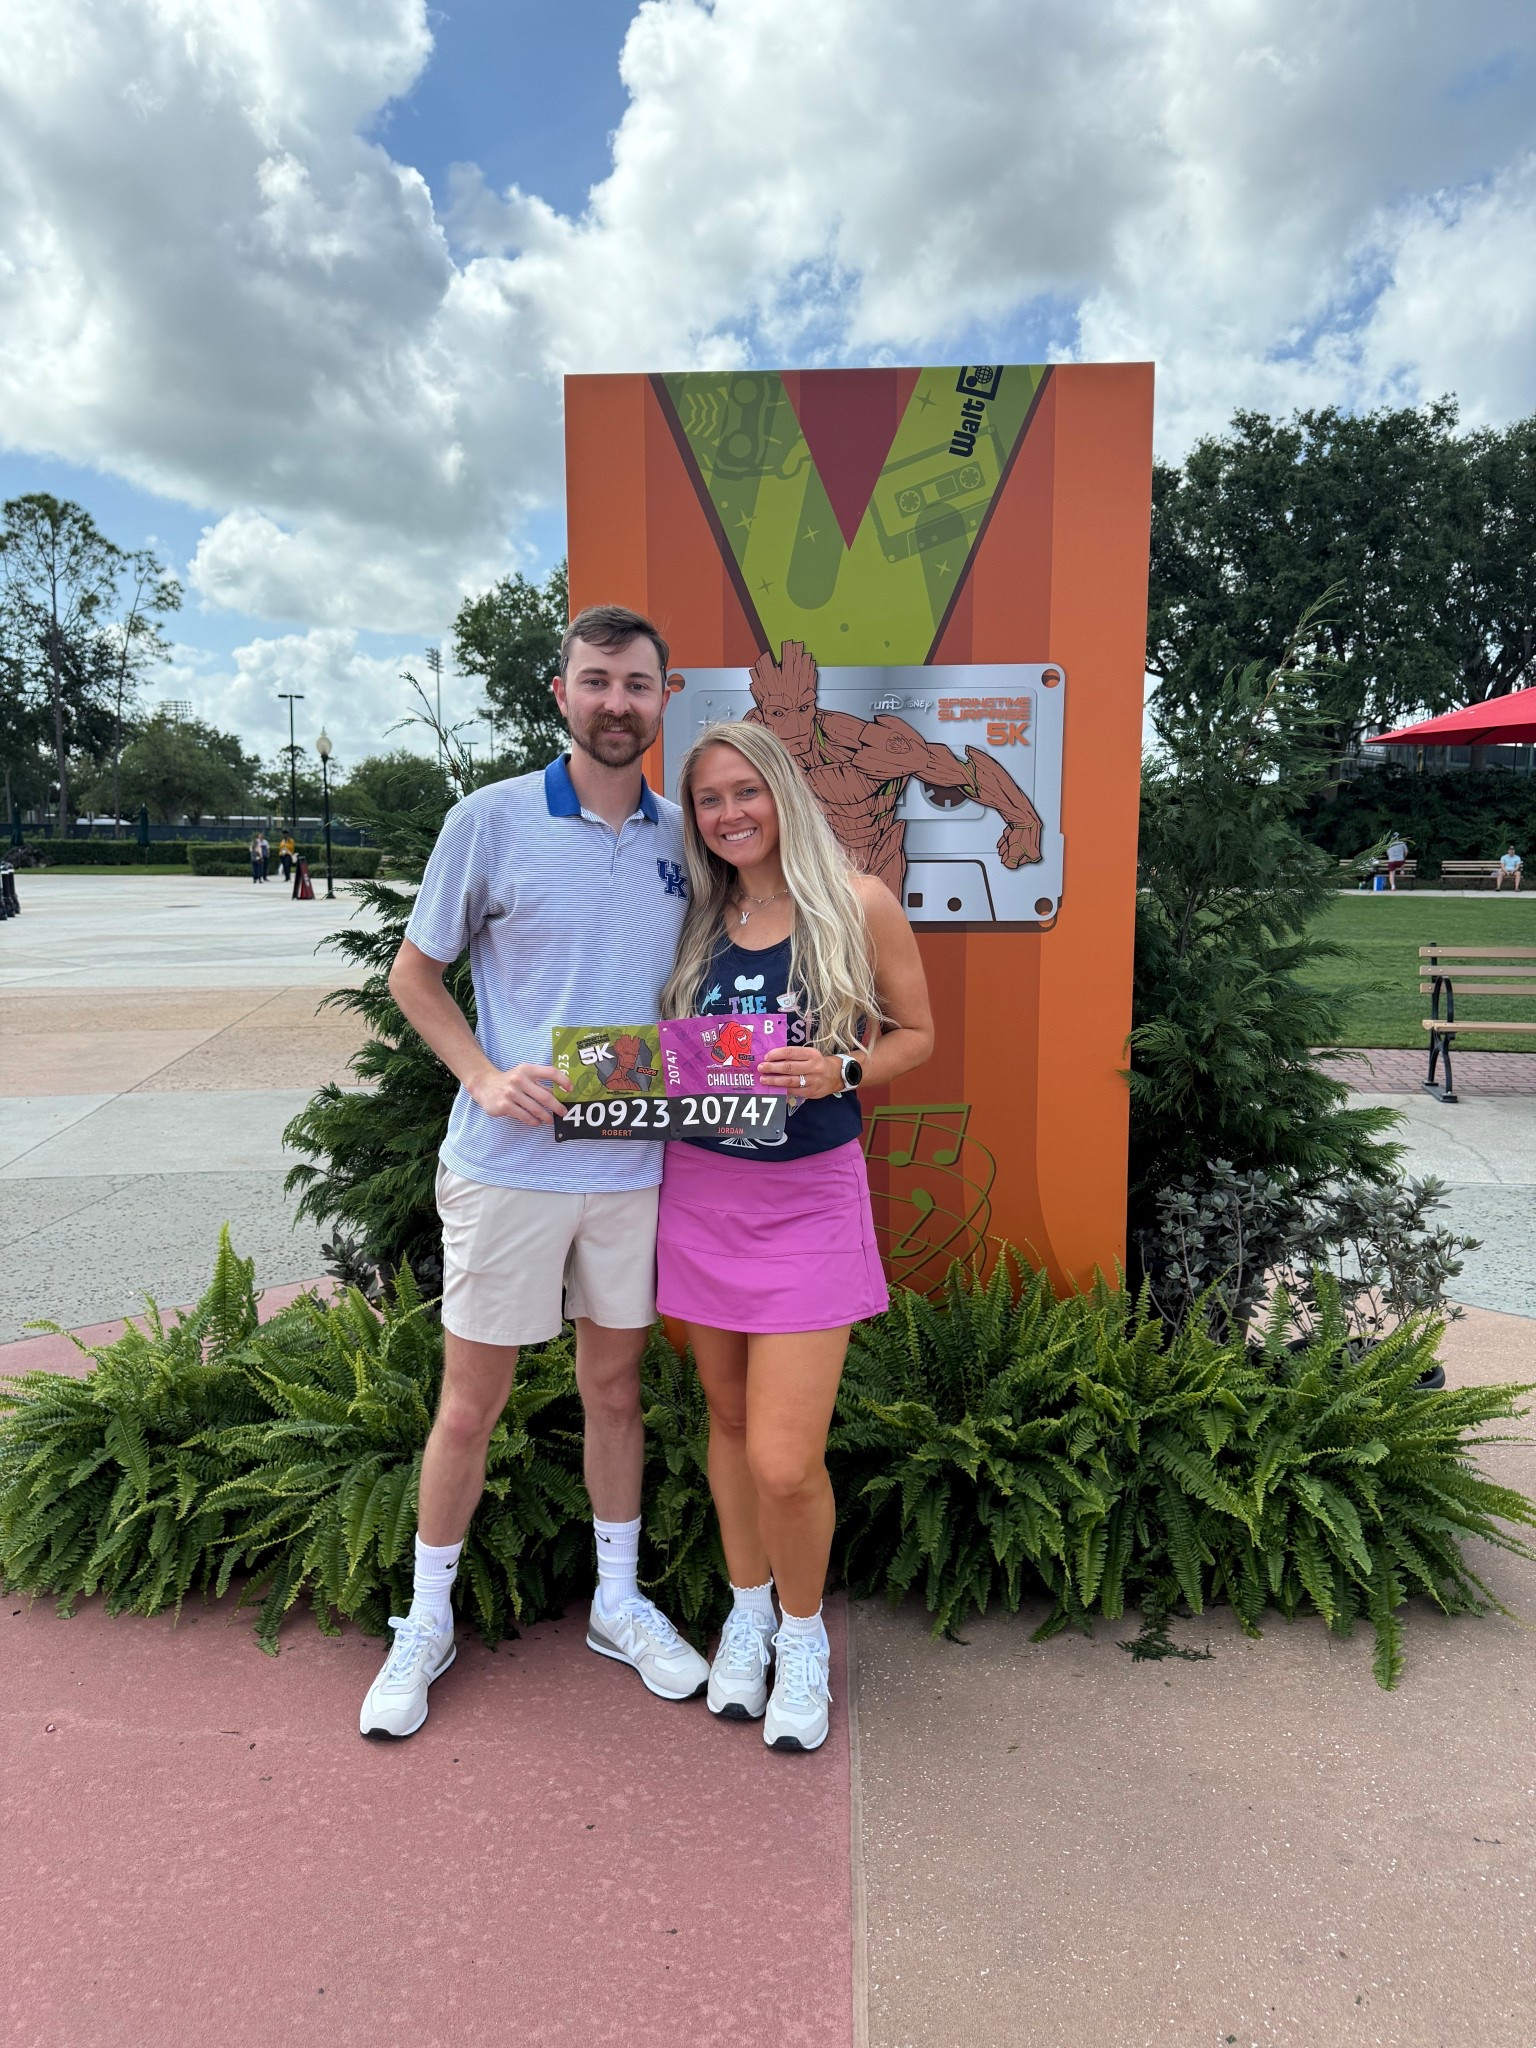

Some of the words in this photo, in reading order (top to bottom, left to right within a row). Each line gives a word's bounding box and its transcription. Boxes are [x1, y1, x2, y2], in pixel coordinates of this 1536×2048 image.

[949, 398, 985, 457] Walt
[938, 697, 1030, 708] SPRINGTIME
[938, 709, 1030, 721] SURPRISE
[987, 722, 1029, 745] 5K
[729, 995, 767, 1014] THE
[764, 1020, 774, 1034] B
[580, 1043, 614, 1066] 5K
[666, 1049, 680, 1085] 20747
[707, 1073, 754, 1086] CHALLENGE
[563, 1099, 670, 1127] 40923
[680, 1096, 777, 1126] 20747
